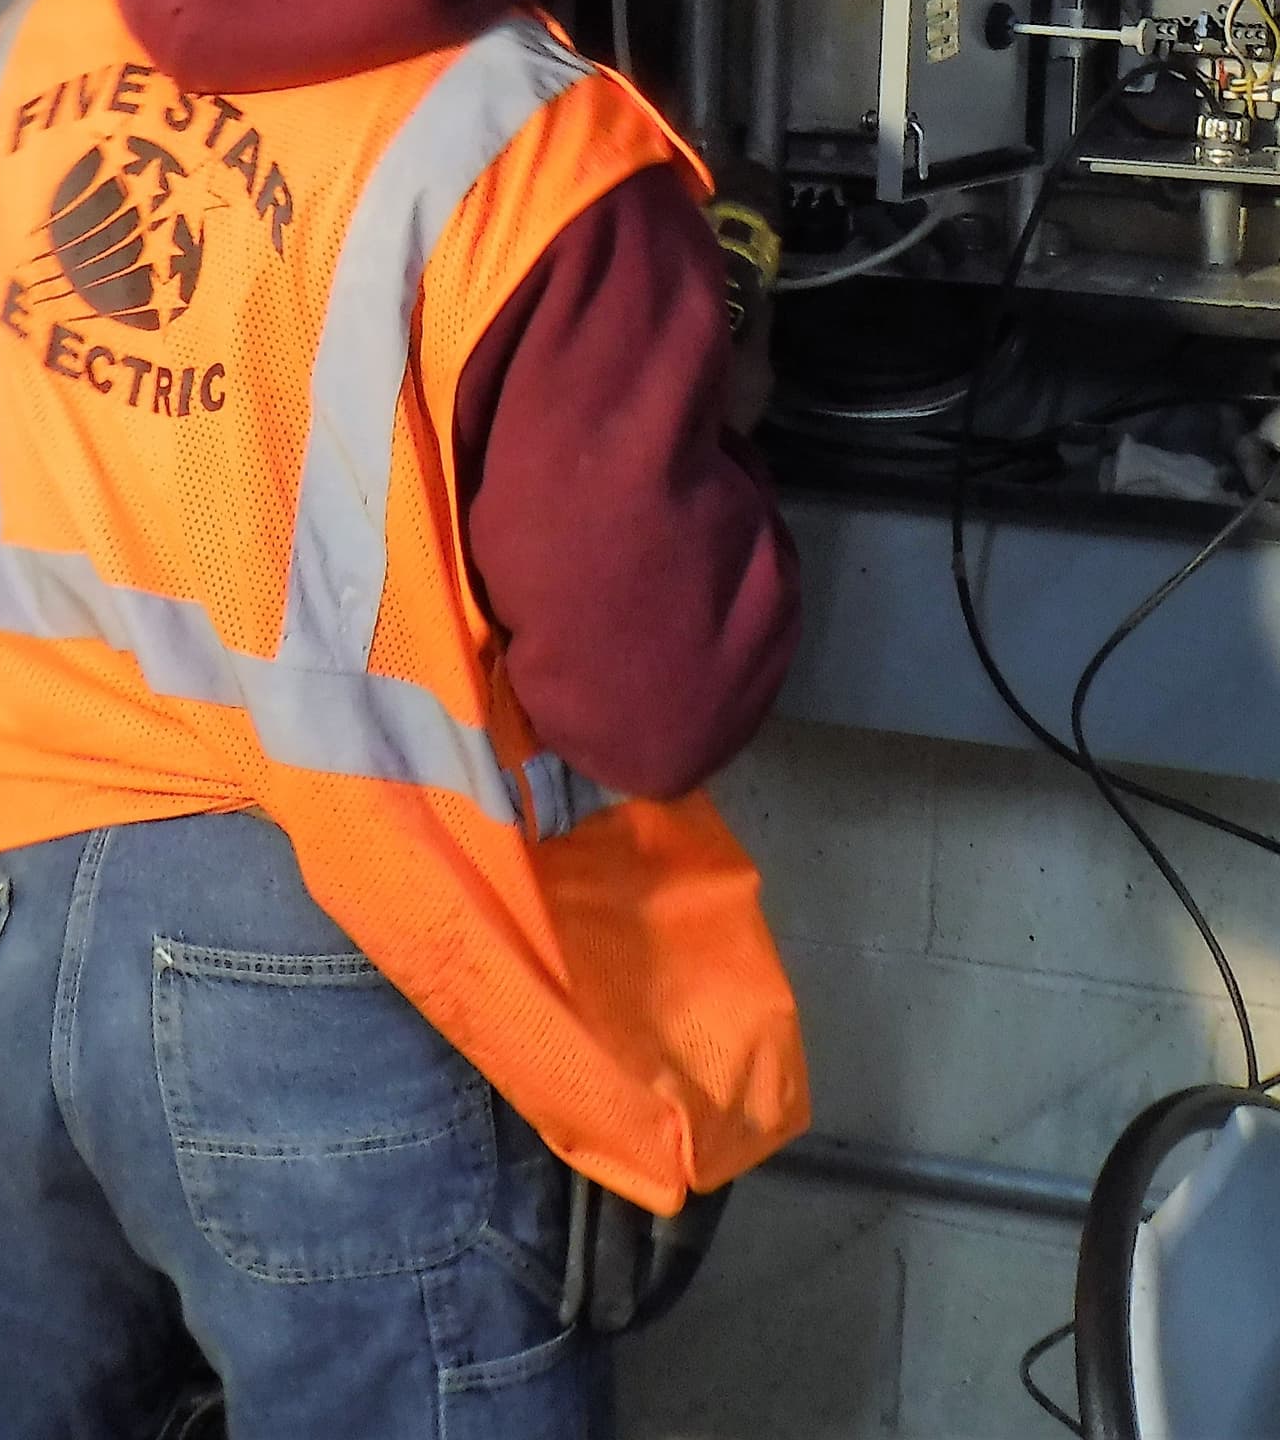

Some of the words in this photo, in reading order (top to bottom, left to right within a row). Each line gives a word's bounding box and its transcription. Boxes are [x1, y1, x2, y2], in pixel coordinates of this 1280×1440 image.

[10, 62, 158, 154] FIVE
[163, 92, 294, 260] STAR
[0, 278, 227, 418] EECTRIC
